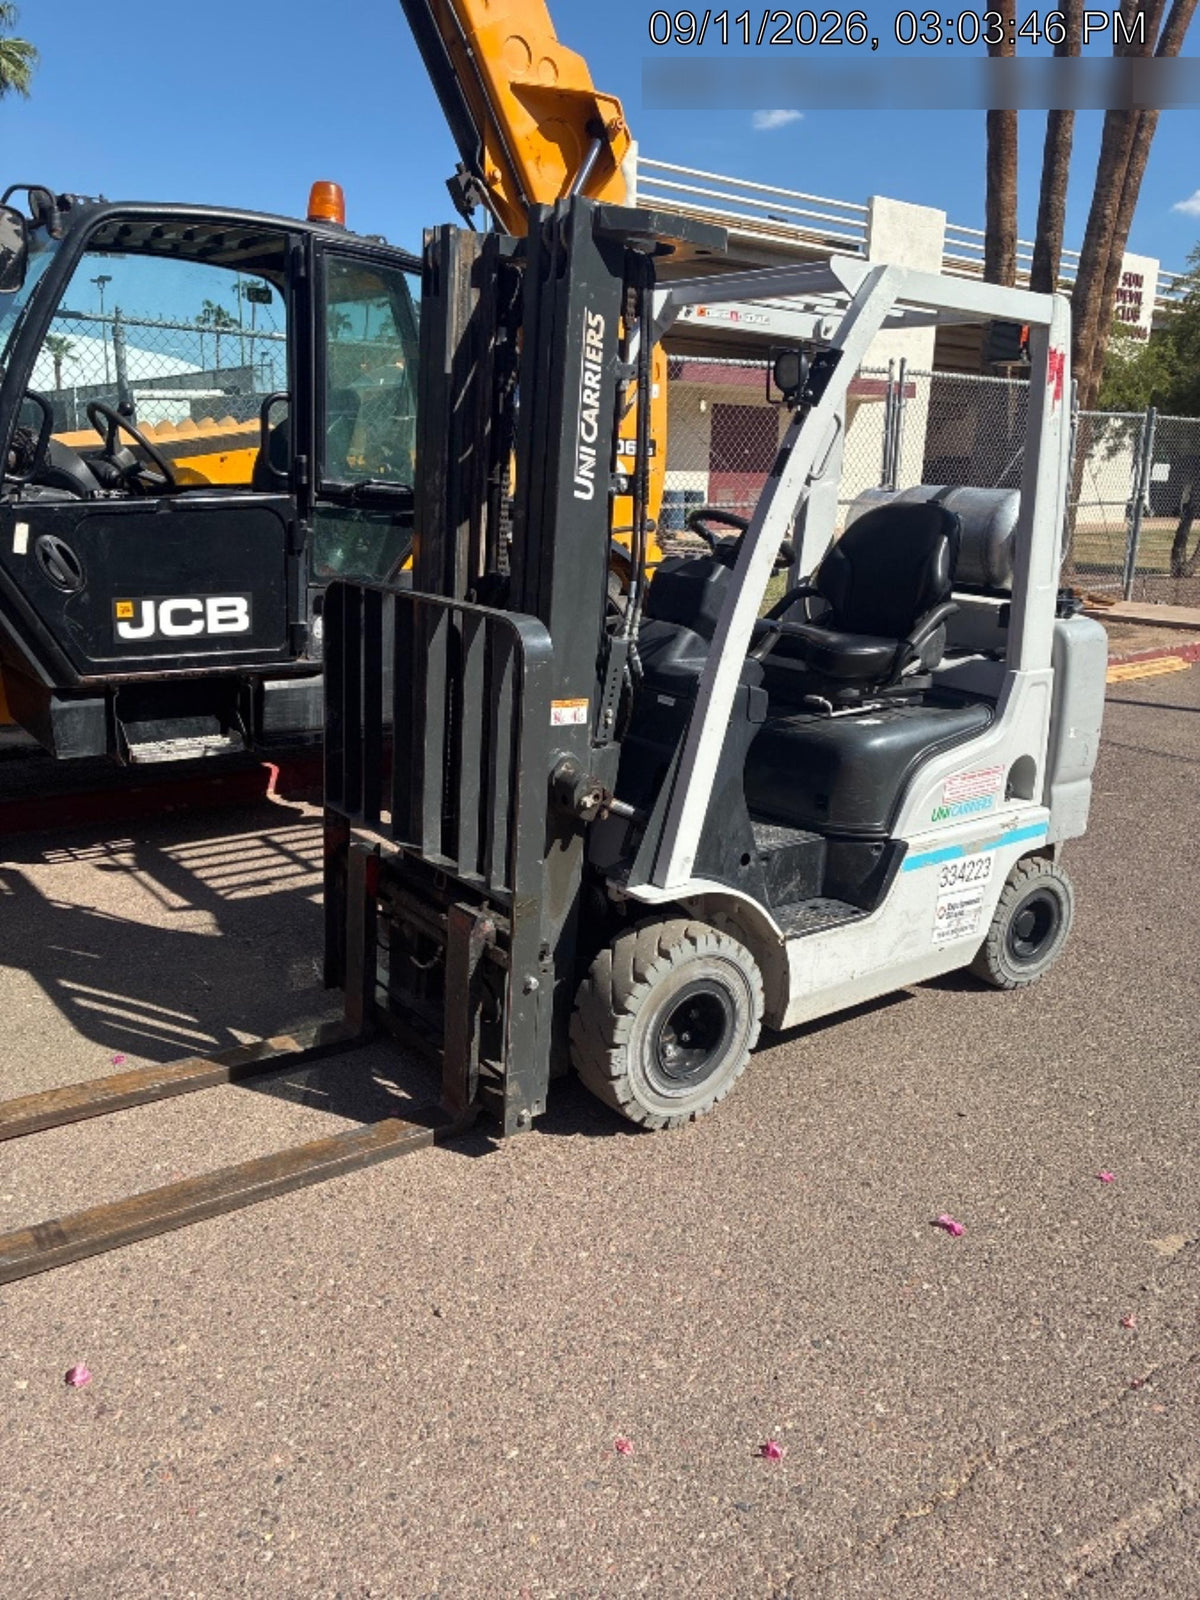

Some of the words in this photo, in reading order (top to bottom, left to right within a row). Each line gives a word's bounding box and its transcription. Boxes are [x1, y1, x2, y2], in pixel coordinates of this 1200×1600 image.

[1121, 272, 1144, 288] SUN
[573, 308, 606, 501] UNICARRIERS
[116, 597, 250, 640] JCB
[939, 856, 992, 888] 334223
